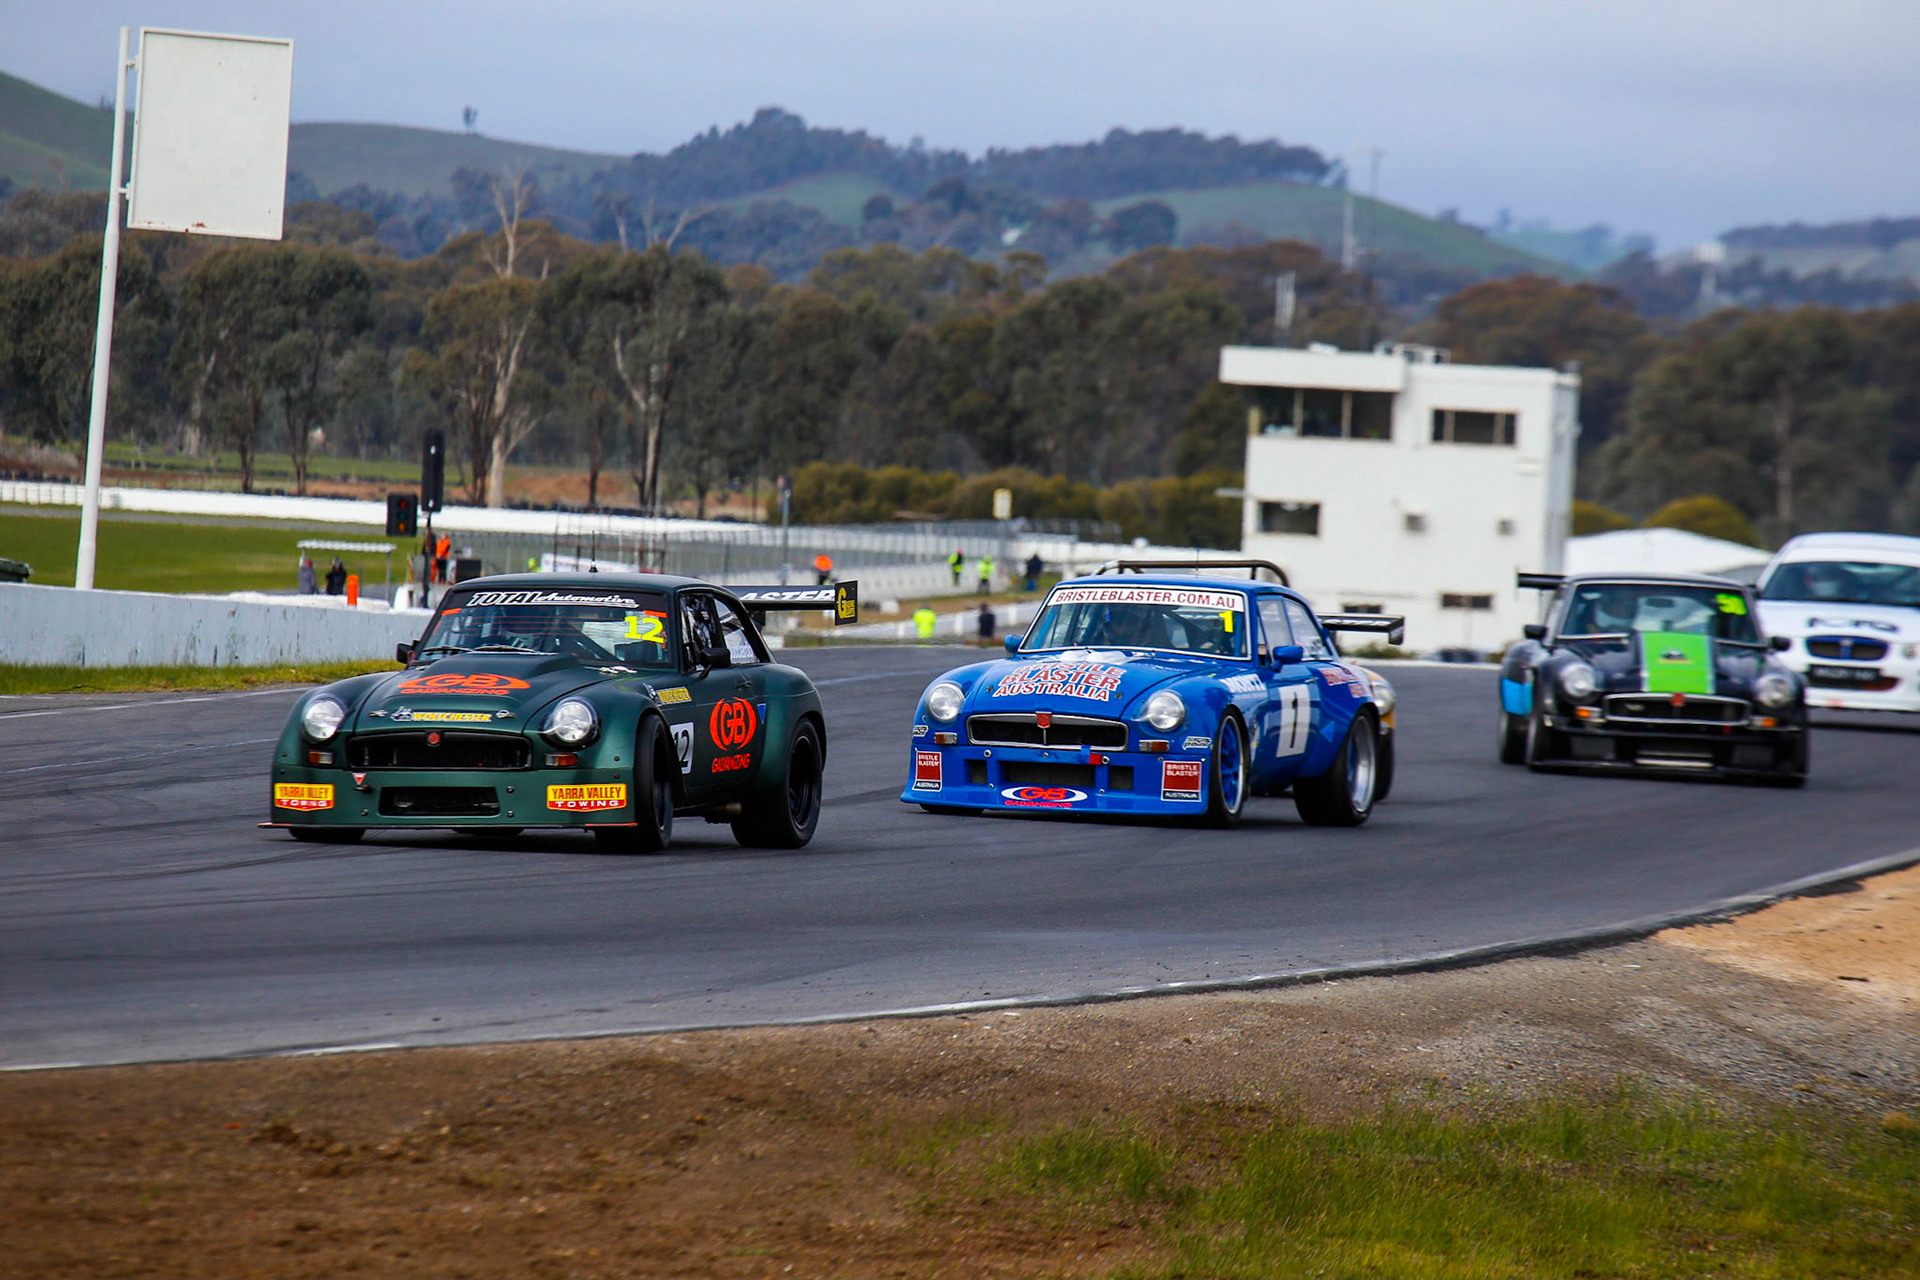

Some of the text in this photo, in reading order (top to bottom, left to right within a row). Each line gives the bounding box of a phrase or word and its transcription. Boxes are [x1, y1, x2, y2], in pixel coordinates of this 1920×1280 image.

[466, 592, 636, 606] TOTAL Automotive
[1055, 590, 1236, 609] BRISTLEBLASTER.COM.AU
[625, 616, 665, 643] 12
[1219, 611, 1234, 633] 1
[998, 668, 1122, 692] BLASTER
[992, 681, 1110, 701] AUSTRALIA
[720, 701, 746, 746] GB
[552, 786, 622, 799] YARRA VALLEY
[1019, 787, 1067, 800] GB
[554, 800, 620, 808] TOWING
